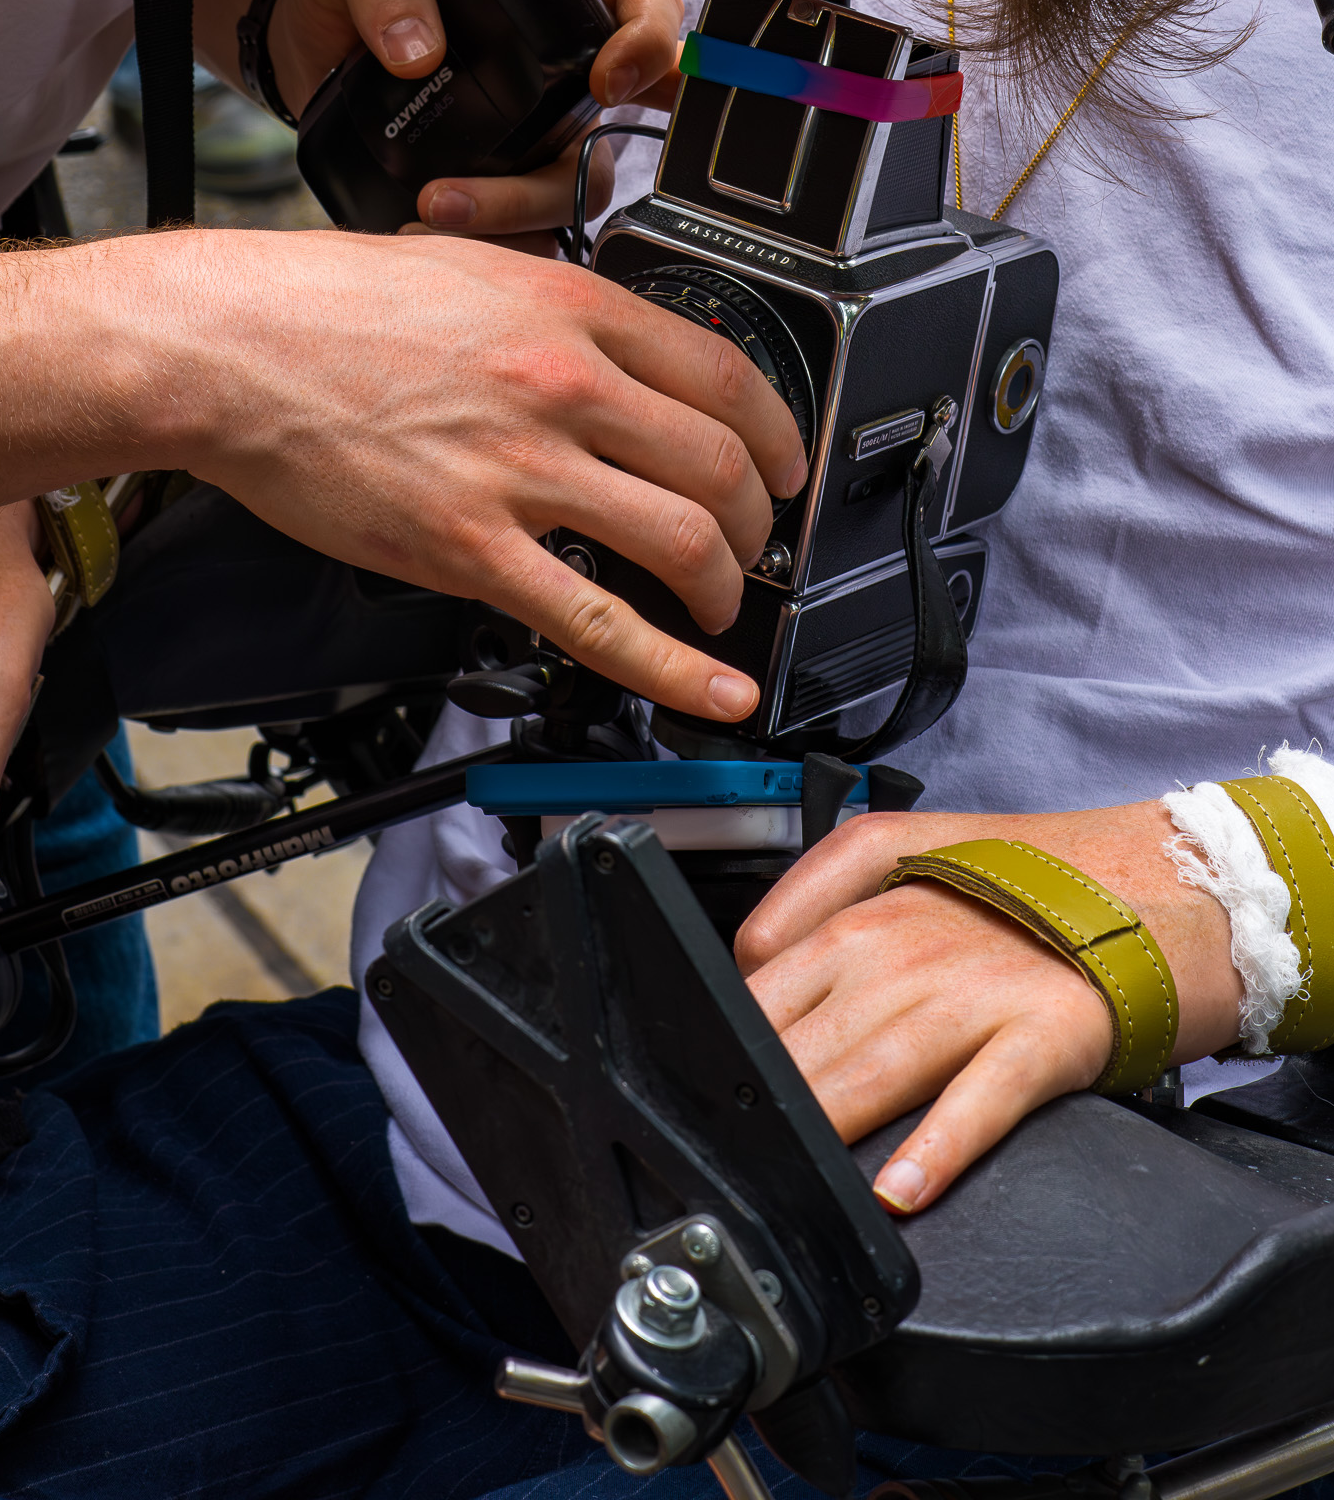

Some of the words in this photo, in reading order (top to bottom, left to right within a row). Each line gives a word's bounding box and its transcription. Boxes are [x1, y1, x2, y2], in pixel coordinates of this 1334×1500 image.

[384, 66, 453, 139] OLYMPUS
[677, 220, 790, 265] HASSELBLAD
[170, 825, 336, 894] Manfrotto
